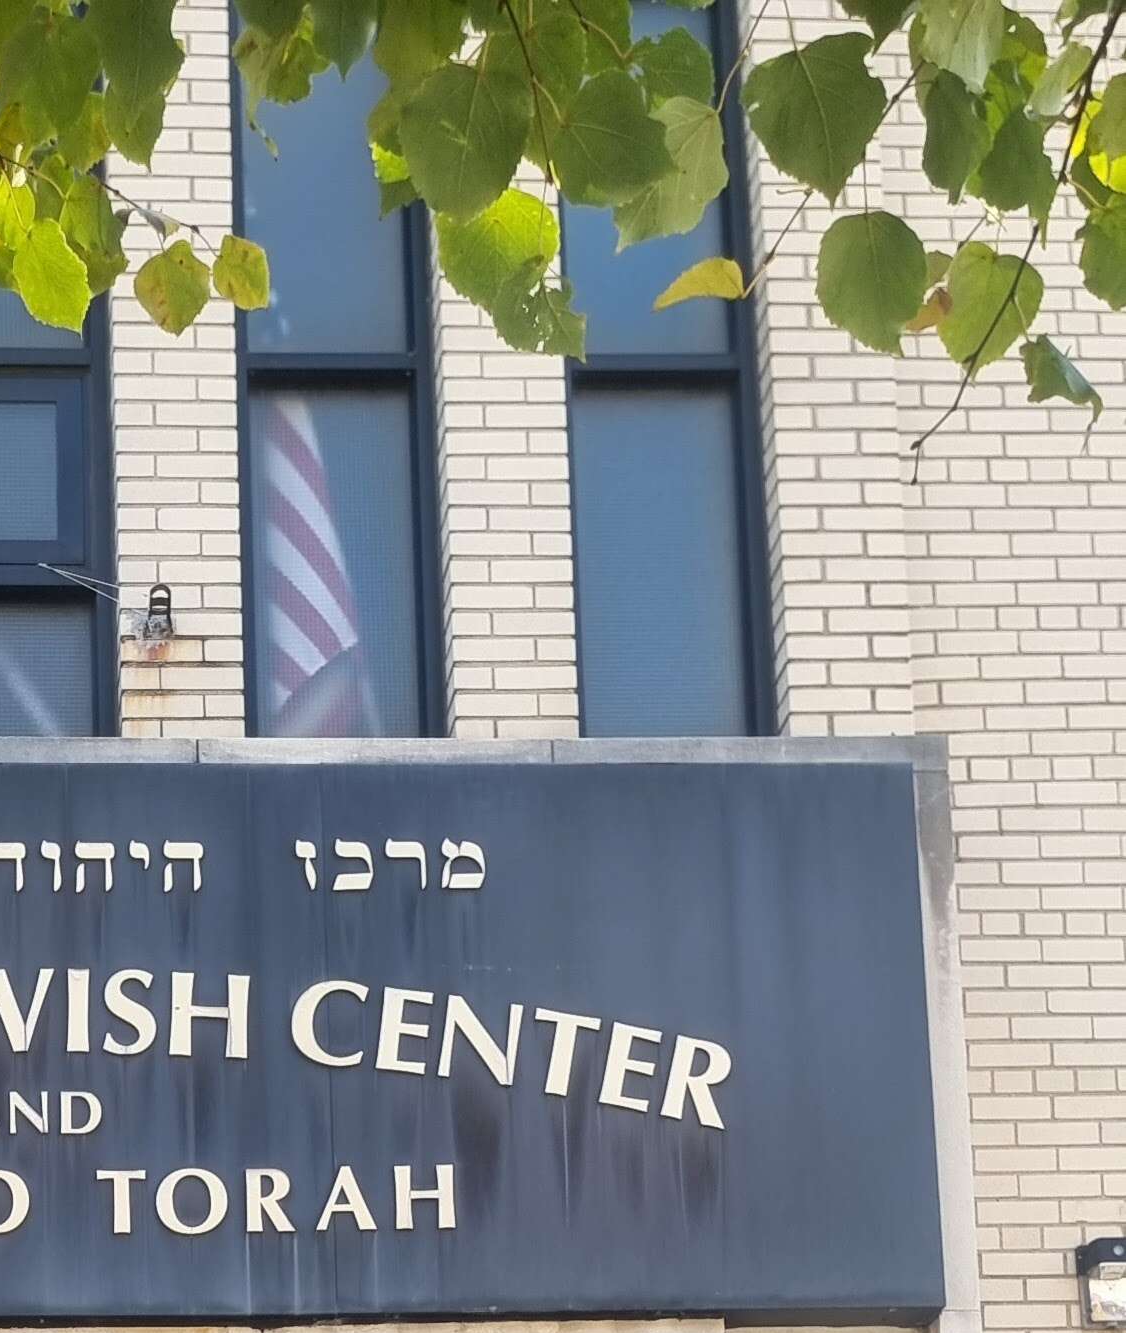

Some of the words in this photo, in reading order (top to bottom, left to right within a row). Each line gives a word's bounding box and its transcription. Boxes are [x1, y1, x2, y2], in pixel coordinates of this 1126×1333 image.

[295, 838, 486, 891] מרכז
[291, 980, 732, 1130] CENTER
[96, 1164, 456, 1235] TORAH
